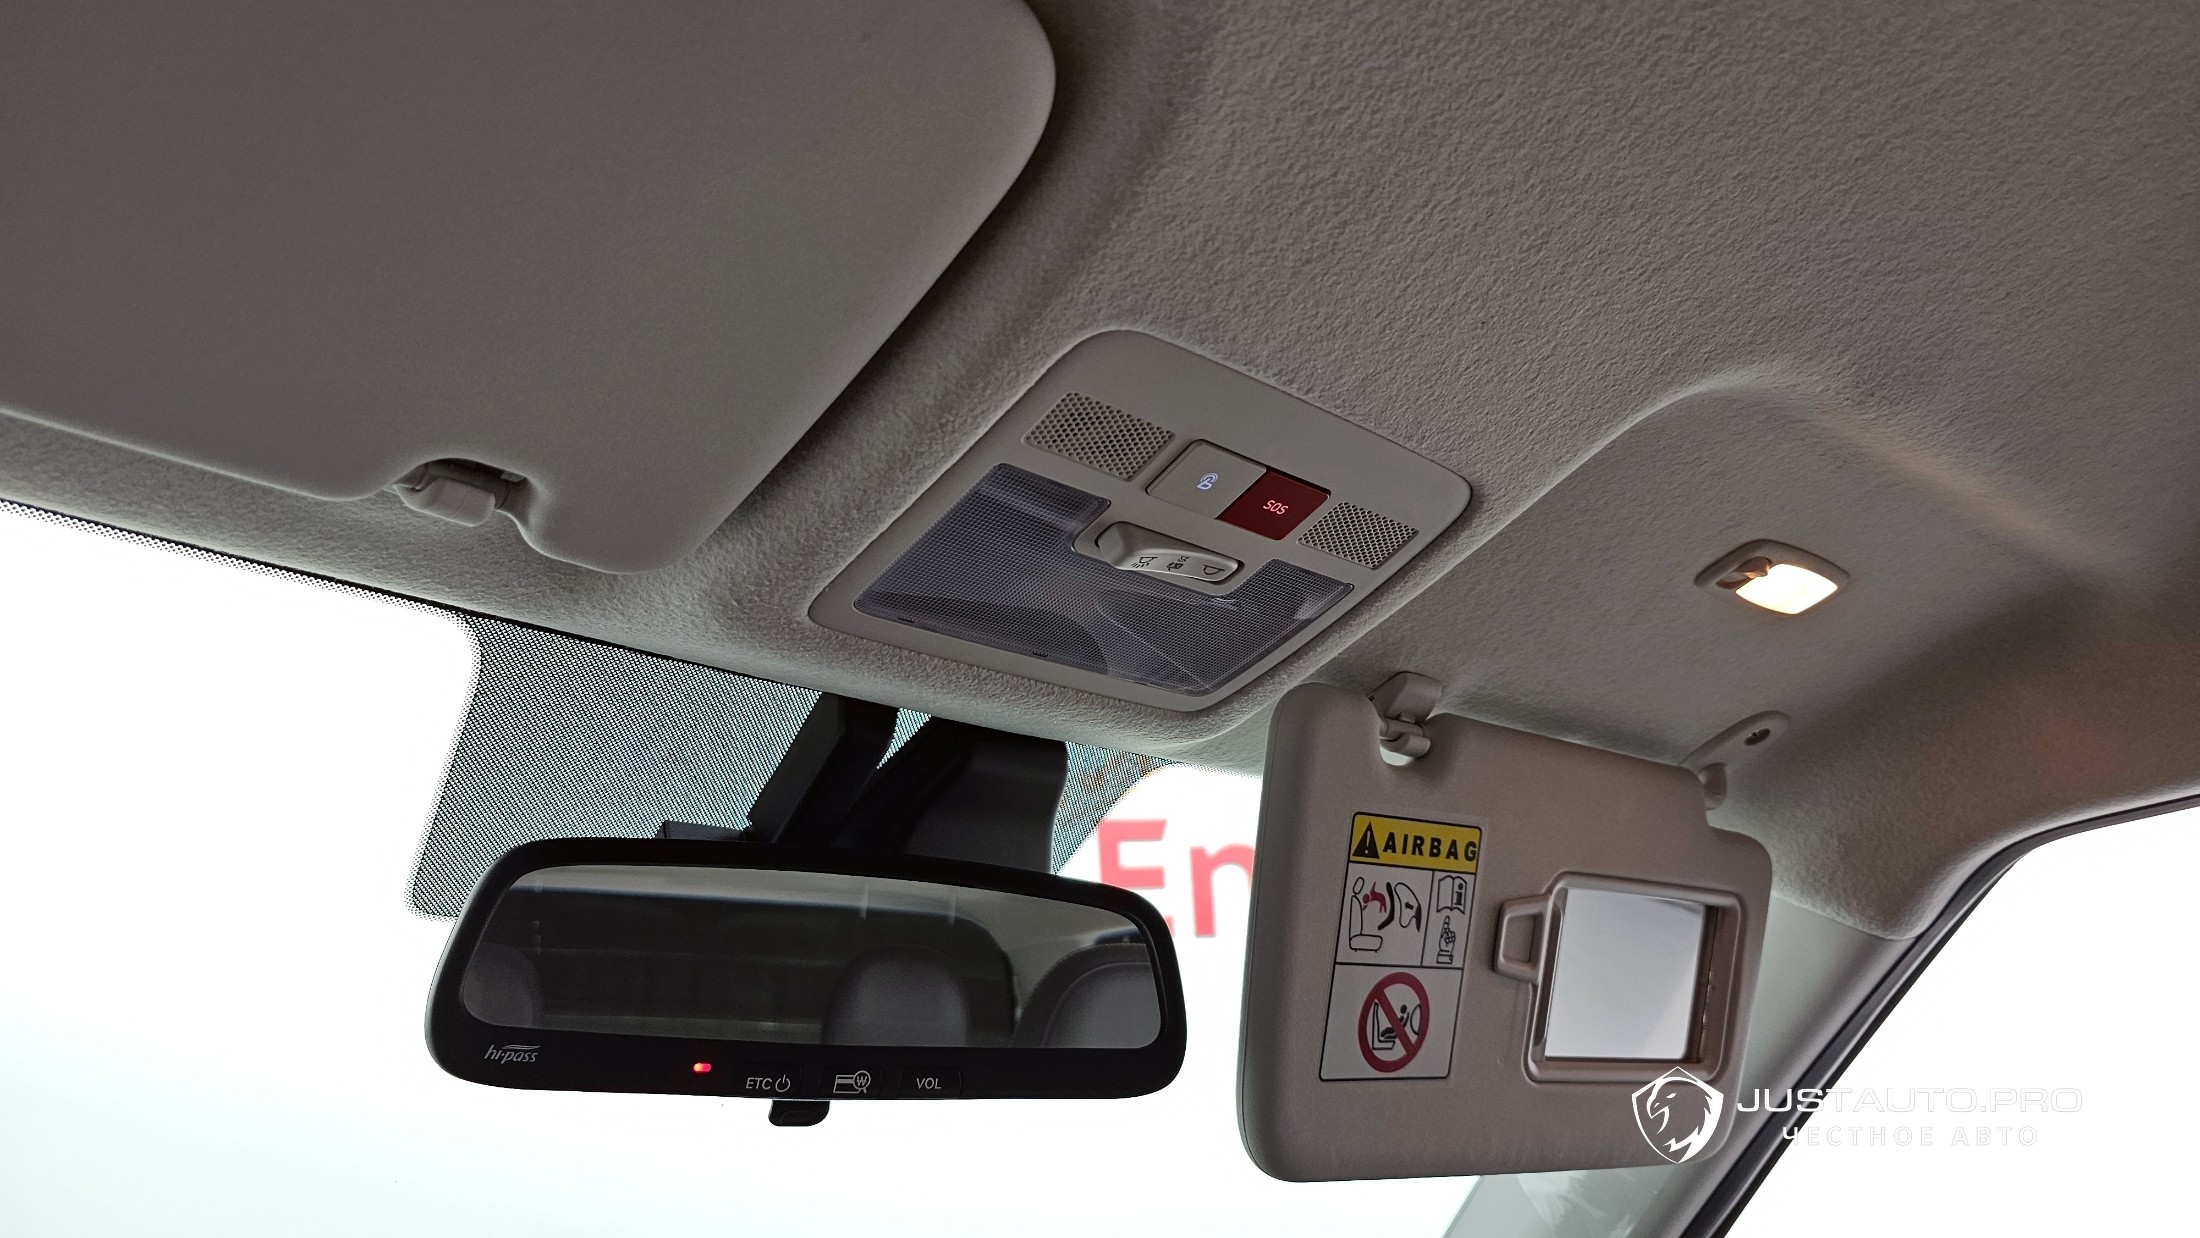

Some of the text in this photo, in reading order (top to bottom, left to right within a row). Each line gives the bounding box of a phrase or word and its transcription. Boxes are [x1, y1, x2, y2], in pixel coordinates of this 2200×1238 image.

[1263, 499, 1289, 515] SOS
[1382, 832, 1477, 862] AIRBAG
[746, 1077, 772, 1091] ETC
[916, 1078, 942, 1090] VOL
